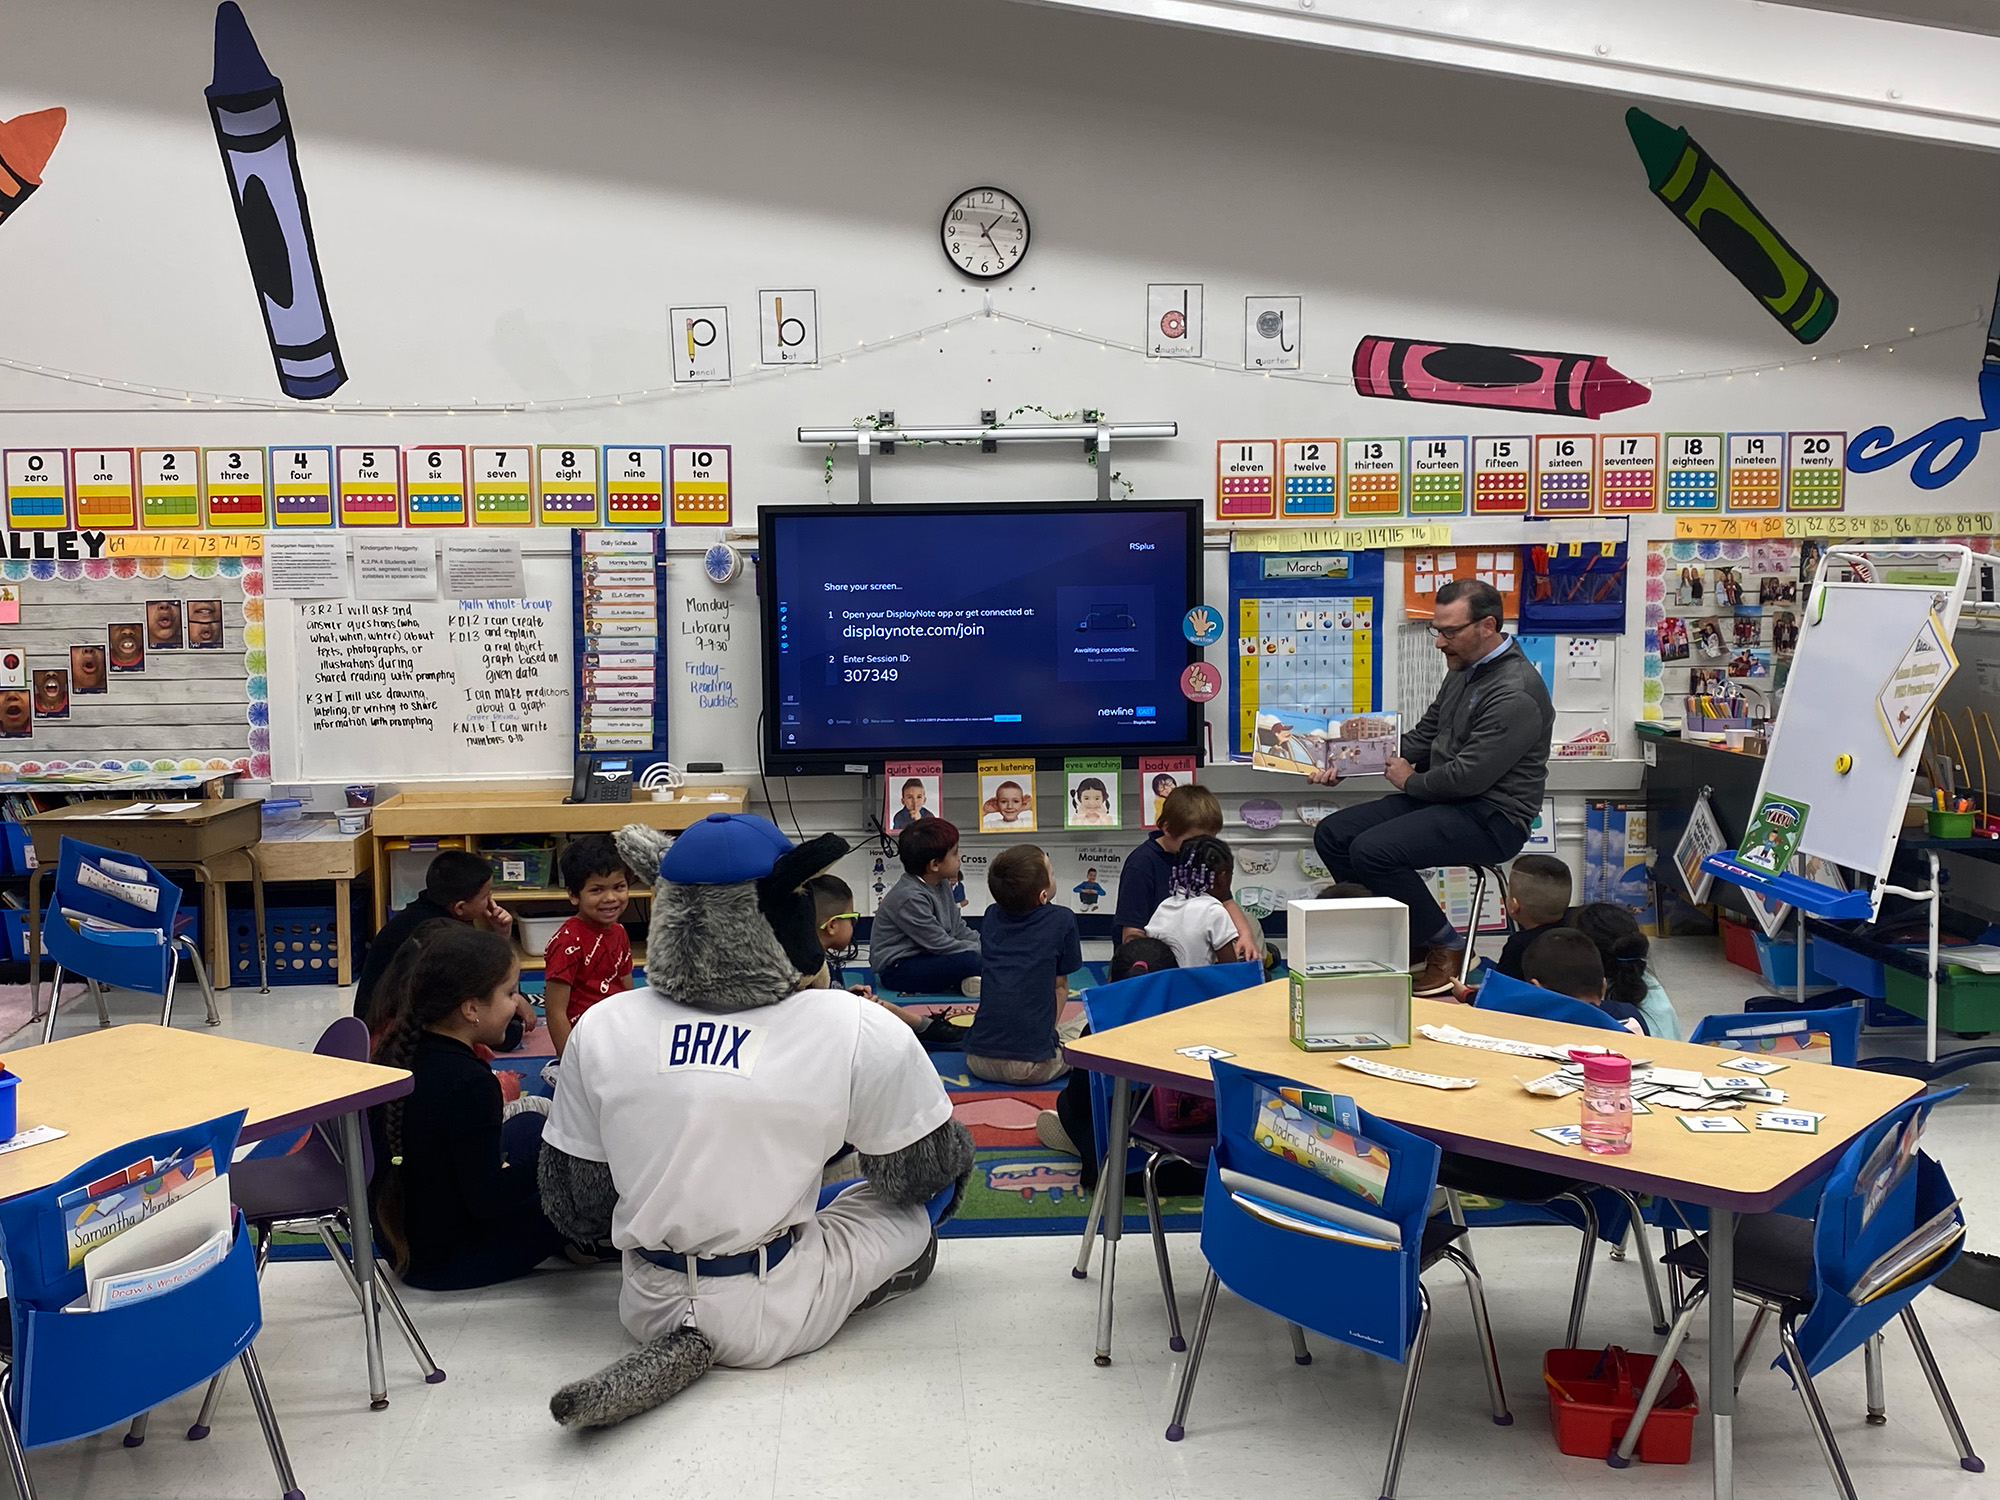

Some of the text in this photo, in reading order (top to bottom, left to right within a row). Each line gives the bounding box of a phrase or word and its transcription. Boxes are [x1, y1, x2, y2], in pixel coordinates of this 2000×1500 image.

[966, 197, 976, 208] 11
[981, 192, 993, 204] 12
[951, 209, 963, 220] 10
[1011, 212, 1019, 223] 2
[948, 226, 956, 237] 9
[1016, 228, 1023, 240] 3
[952, 242, 960, 254] 8
[1010, 245, 1018, 256] 4
[965, 257, 973, 268] 7
[981, 261, 989, 273] 6
[997, 258, 1005, 269] 5
[782, 351, 797, 360] bat
[1255, 358, 1290, 366] quarter
[689, 368, 716, 378] pencil
[1364, 444, 1383, 459] 13
[1428, 443, 1447, 458] 14
[1493, 442, 1511, 457] 15
[1556, 441, 1574, 456] 16
[1620, 440, 1637, 455] 17
[1685, 439, 1703, 455] 18
[1747, 439, 1764, 454] 19
[1804, 439, 1830, 454] 20
[561, 451, 576, 467] 8
[629, 451, 642, 467] 9
[1241, 446, 1253, 461] 11
[1301, 445, 1320, 461] 12
[28, 455, 43, 470] 0
[100, 455, 105, 470] 1
[162, 454, 175, 470] 2
[228, 453, 242, 469] 3
[294, 452, 308, 468] 4
[362, 453, 375, 468] 5
[428, 452, 442, 468] 6
[495, 452, 507, 467] 7
[692, 452, 713, 468] 10
[1354, 460, 1394, 470] thirteen
[1416, 460, 1459, 470] fourteen
[1485, 458, 1519, 468] fifteen
[1549, 458, 1583, 468] sixteen
[1604, 457, 1654, 466] seventeen
[1672, 456, 1714, 468] eighteen
[1735, 455, 1777, 465] nineteen
[1800, 456, 1834, 467] twenty
[624, 469, 645, 478] nine
[1230, 463, 1264, 472] eleven
[1294, 463, 1326, 472] twelve
[24, 473, 49, 483] zero
[93, 472, 113, 482] one
[160, 472, 179, 482] two
[220, 471, 250, 481] three
[290, 470, 313, 480] four
[358, 469, 379, 479] five
[428, 469, 442, 479] six
[487, 471, 517, 479] seven
[555, 469, 581, 480] eight
[693, 470, 709, 479] ten
[1721, 513, 1992, 535] 78 80 82 83 86 90
[1368, 528, 1425, 544] 114 116
[109, 535, 261, 552] 69 73 74 75
[1129, 542, 1155, 552] RSplus
[1286, 561, 1322, 573] March
[824, 582, 848, 591] Share
[850, 584, 867, 593] your
[337, 603, 412, 616] I will ask and
[459, 599, 483, 611] Math
[827, 610, 833, 619] 1
[842, 610, 864, 620] Open
[865, 611, 884, 621] your
[886, 608, 936, 620] DisplayNote
[938, 611, 954, 620] app
[965, 609, 979, 619] get
[980, 608, 1022, 617] connected
[1023, 607, 1035, 616] at:
[306, 619, 395, 632] answer questions
[491, 615, 544, 627] can create
[404, 631, 435, 641] about
[682, 622, 731, 642] Library
[842, 623, 985, 641] displaynote.com/join
[494, 640, 544, 655] real object
[1074, 646, 1099, 655] Awaiting
[482, 652, 559, 669] graph based on
[828, 654, 911, 663] 2 Enter Session ID:
[320, 657, 414, 673] illustrations during
[351, 672, 386, 686] reading
[486, 666, 538, 684] given data
[843, 668, 898, 683] 307349
[691, 681, 733, 697] Reading
[700, 694, 739, 708] Buddies
[476, 702, 504, 714] about
[1098, 706, 1154, 717] newline CAST
[313, 717, 368, 731] information
[886, 763, 942, 776] quiet voice
[979, 762, 1035, 773] ears listening
[1065, 760, 1122, 771] eyes watching
[1144, 759, 1191, 772] body still
[1766, 810, 1792, 828] YAKYU
[961, 854, 987, 864] Cross
[1078, 852, 1121, 863] Mountain
[669, 1021, 752, 1070] BRIX
[1308, 1102, 1327, 1114] Agree
[1306, 1134, 1344, 1168] Brewer
[74, 1210, 136, 1248] Samantha
[111, 1285, 143, 1300] Draw
[146, 1281, 153, 1291] &
[155, 1273, 183, 1289] Write
